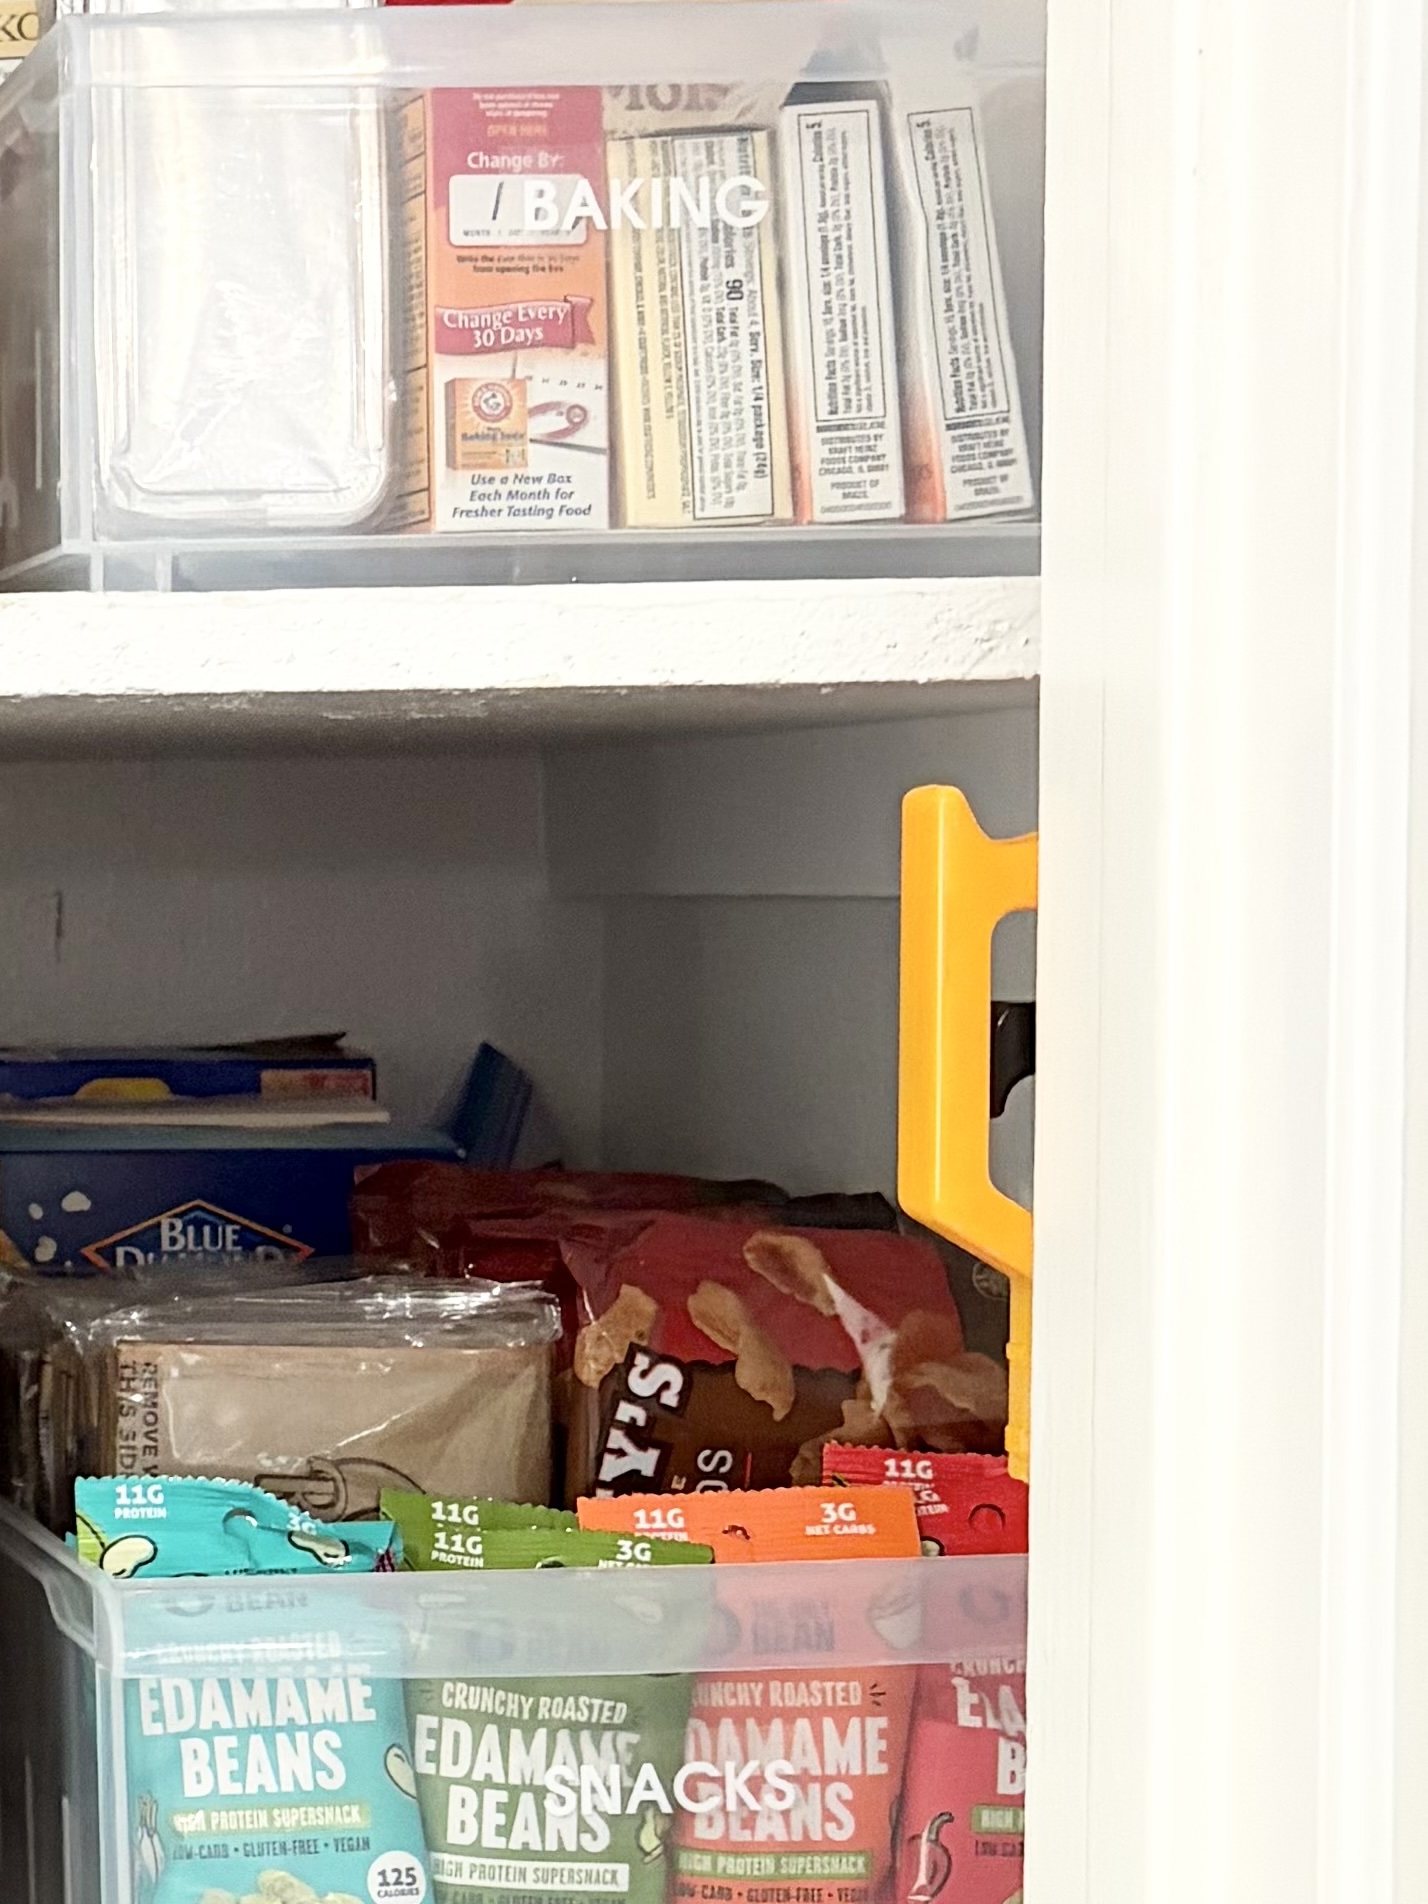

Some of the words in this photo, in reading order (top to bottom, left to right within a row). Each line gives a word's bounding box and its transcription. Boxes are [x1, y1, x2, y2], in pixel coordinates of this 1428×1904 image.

[523, 175, 769, 231] BAKING
[443, 306, 513, 332] Change
[518, 304, 568, 326] Every
[473, 328, 497, 348] 30
[501, 324, 544, 344] Days
[452, 503, 502, 519] Fresher
[507, 502, 553, 520] Tasting
[559, 502, 591, 518] Food
[115, 1484, 164, 1506] 11G
[114, 1506, 166, 1520] PROTEIN
[821, 1502, 855, 1523] 3G
[140, 1667, 376, 1735] EDAMAME
[181, 1732, 347, 1797] BEANS
[543, 1760, 798, 1816] SNACKS
[378, 1867, 417, 1887] 125
